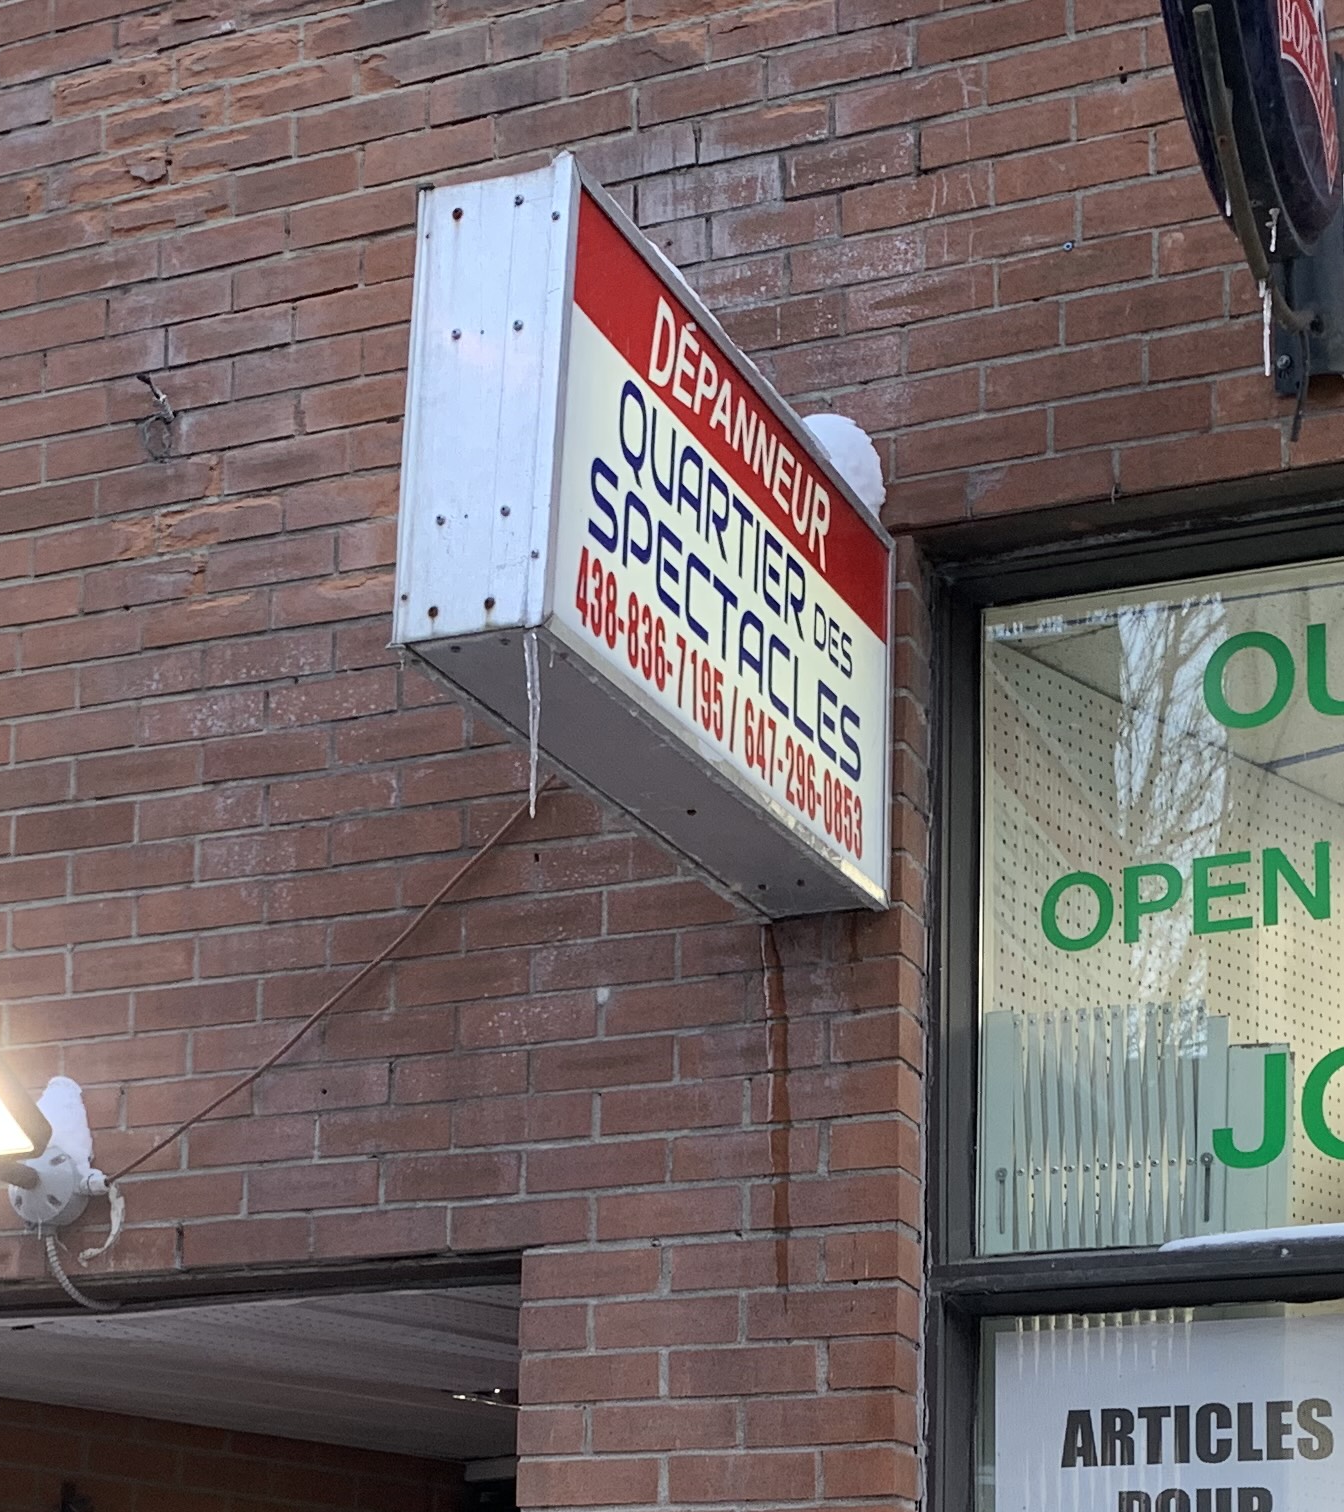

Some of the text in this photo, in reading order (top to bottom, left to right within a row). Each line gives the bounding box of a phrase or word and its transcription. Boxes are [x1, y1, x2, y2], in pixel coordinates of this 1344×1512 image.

[619, 379, 854, 679] QUARTIER DES
[649, 295, 832, 573] DÉPANNEUR
[575, 545, 724, 742] 438-836-7195
[744, 697, 864, 861] 647-296-0853
[587, 456, 862, 782] SPECTACLES
[1040, 839, 1332, 953] OPEN
[1061, 1397, 1335, 1468] ARTICLES
